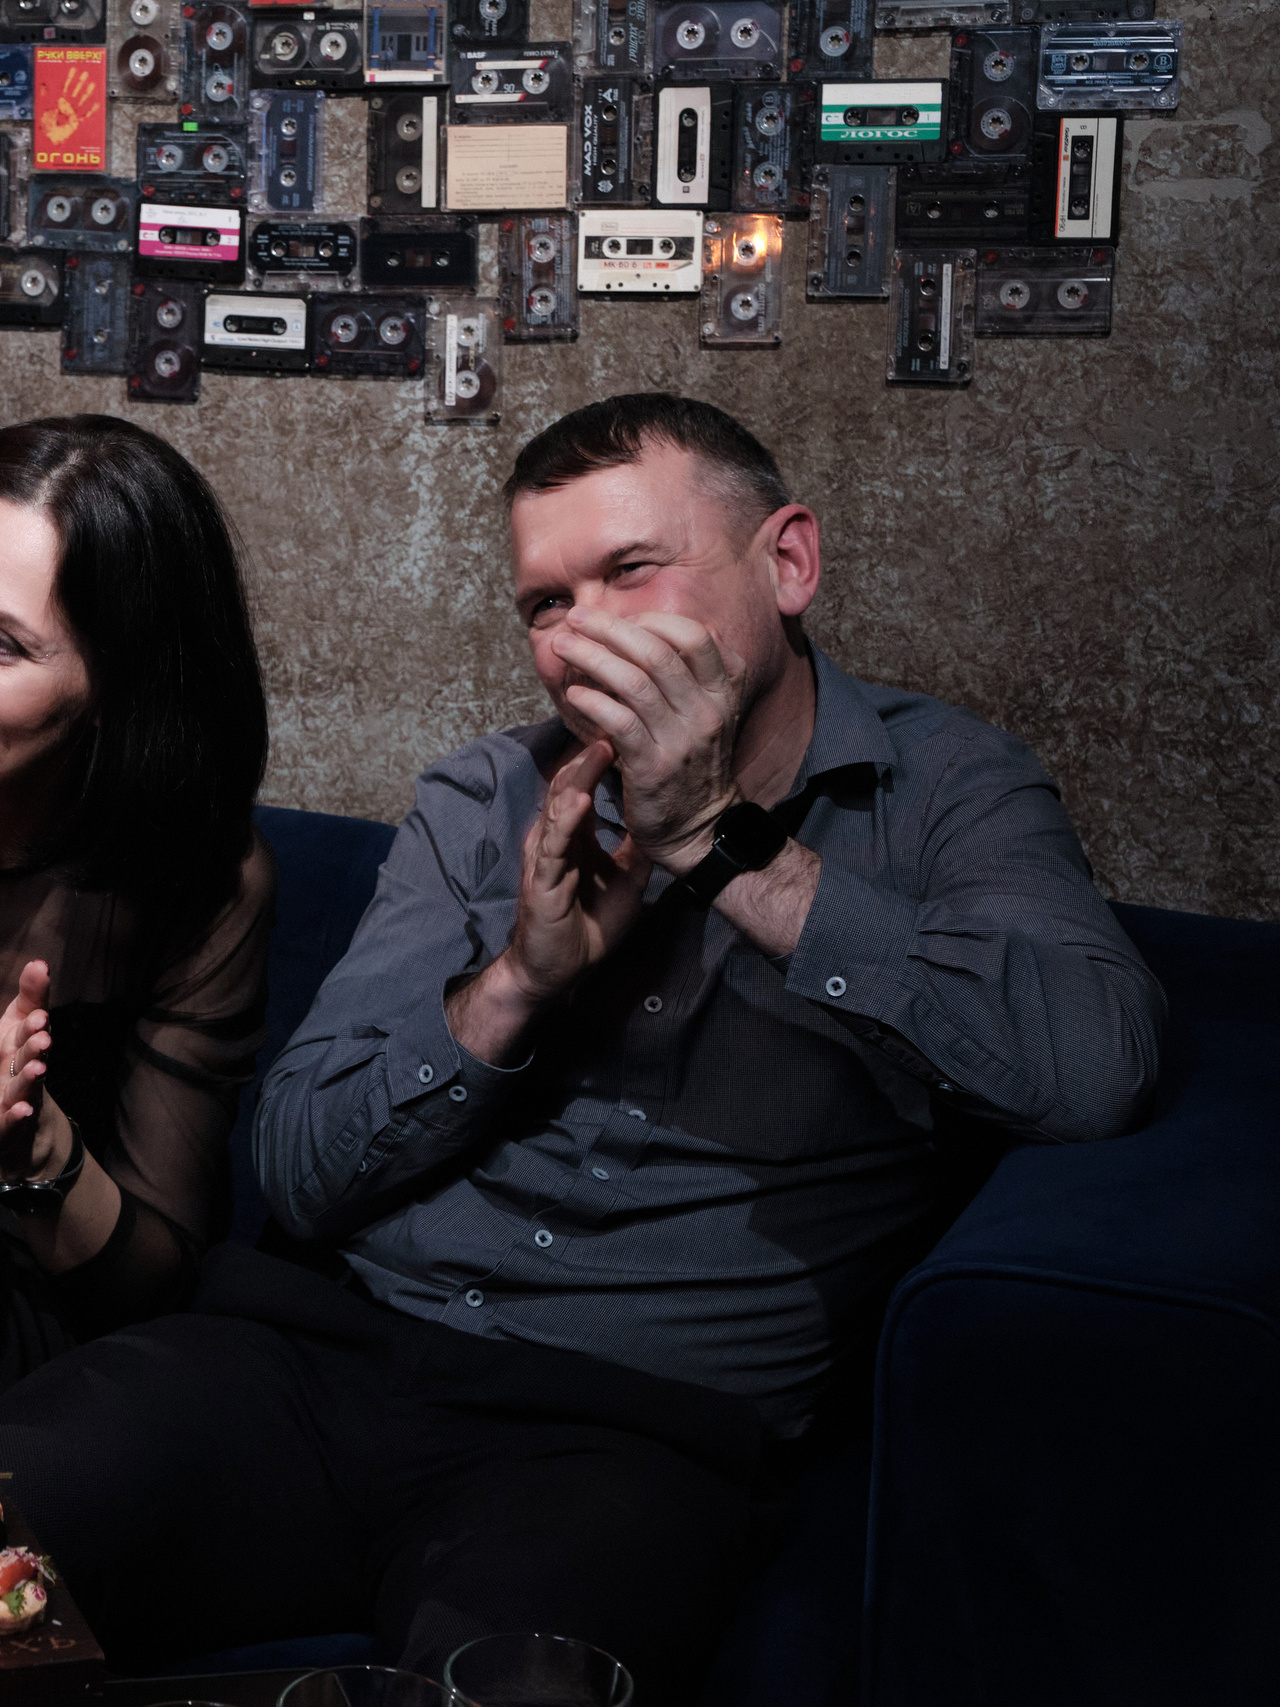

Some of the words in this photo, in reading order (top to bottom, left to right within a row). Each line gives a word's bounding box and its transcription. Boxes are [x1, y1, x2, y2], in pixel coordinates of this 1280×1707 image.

[37, 50, 64, 59] РУКИ
[466, 51, 487, 59] BASF
[1159, 55, 1168, 65] B
[503, 83, 515, 93] 90
[583, 104, 592, 138] VOX
[840, 130, 918, 138] ЛОГОС
[36, 152, 100, 164] ОГОНЬ
[583, 140, 592, 176] MAD
